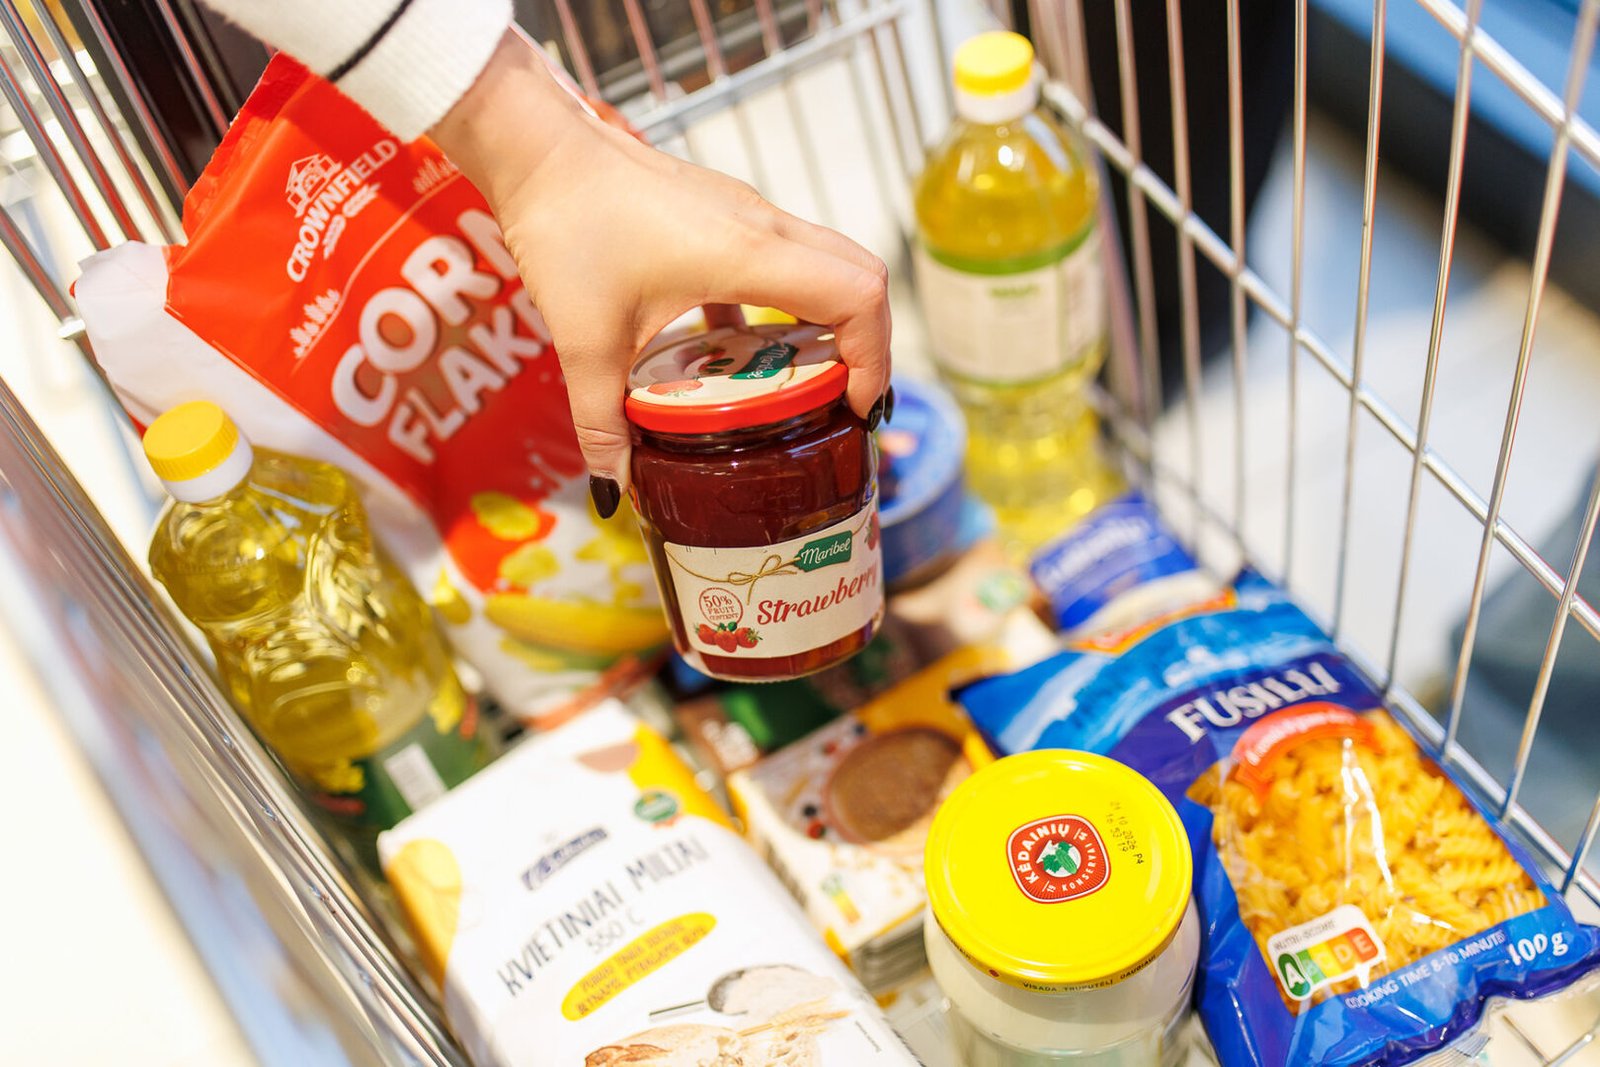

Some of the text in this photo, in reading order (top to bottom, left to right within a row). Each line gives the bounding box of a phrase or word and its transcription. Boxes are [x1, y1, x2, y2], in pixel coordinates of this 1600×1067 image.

[287, 140, 397, 283] CROWNFIELD
[800, 538, 851, 565] Maribel
[703, 594, 733, 609] 50%
[707, 605, 735, 615] FRUIT
[757, 561, 877, 626] Strawberry
[1017, 823, 1070, 885] KĖDAINIŲ
[1061, 842, 1097, 892] KONSERVAI
[497, 881, 624, 998] KVIETINIAI
[1551, 931, 1569, 958] g
[1023, 982, 1057, 992] VISADA
[1399, 965, 1432, 987] TIME
[1431, 952, 1460, 974] 8-10
